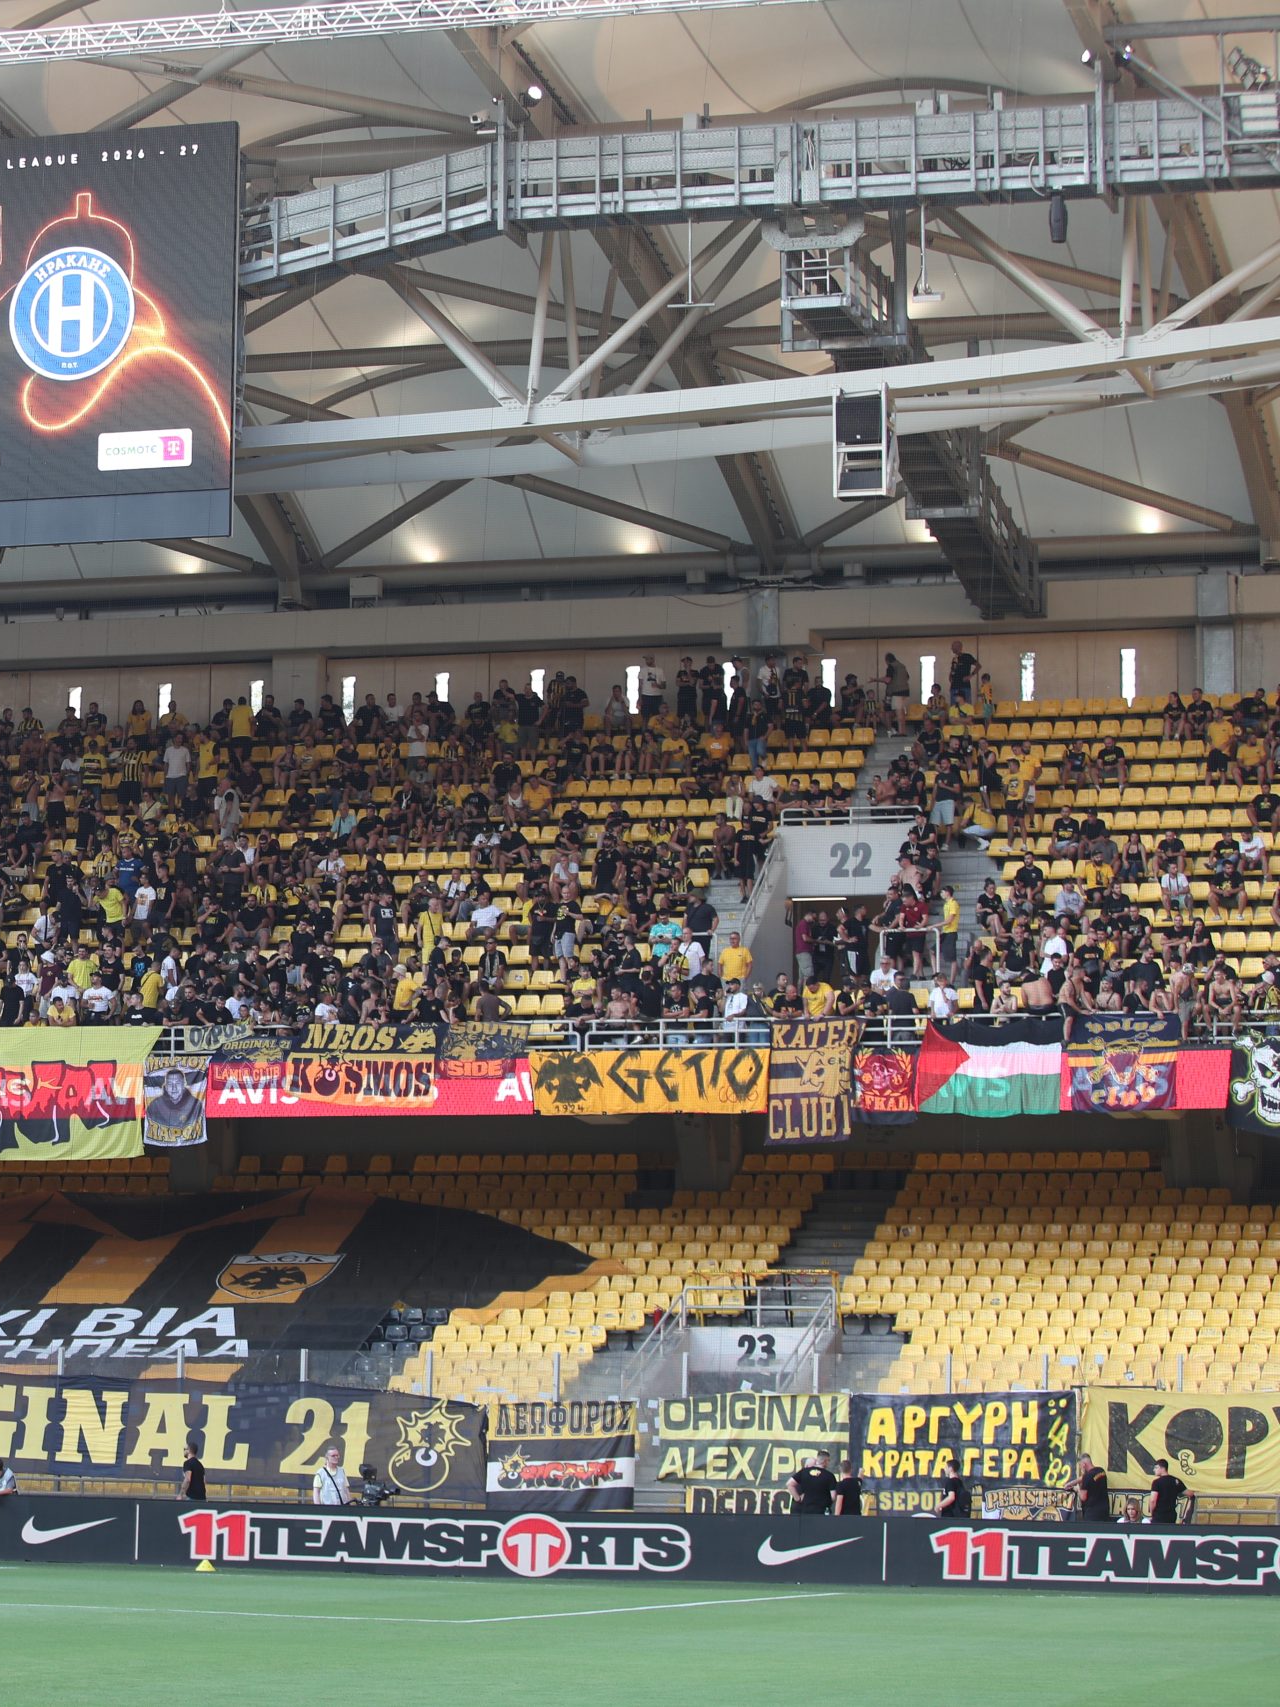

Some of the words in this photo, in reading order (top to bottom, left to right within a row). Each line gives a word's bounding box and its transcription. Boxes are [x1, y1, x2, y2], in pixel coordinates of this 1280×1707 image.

[7, 153, 79, 169] LEAGUE
[180, 144, 199, 156] 27
[34, 254, 111, 283] ΗΡΑΚΛΗΣ
[829, 842, 872, 878] 22
[224, 1039, 277, 1050] ORIGINAL
[279, 1039, 292, 1049] 21
[301, 1024, 398, 1051] NEOS
[449, 1022, 528, 1040] SOUTH
[215, 1066, 250, 1082] LAMIA
[253, 1065, 281, 1082] CLUB
[447, 1061, 503, 1078] SIDE
[554, 1104, 585, 1114] 1924
[770, 1097, 837, 1139] CLUB
[737, 1334, 776, 1367] 23
[664, 1392, 850, 1433] ORIGINAL
[866, 1400, 1039, 1445] ΑΡΓΥΡΗ
[280, 1397, 373, 1478] 21
